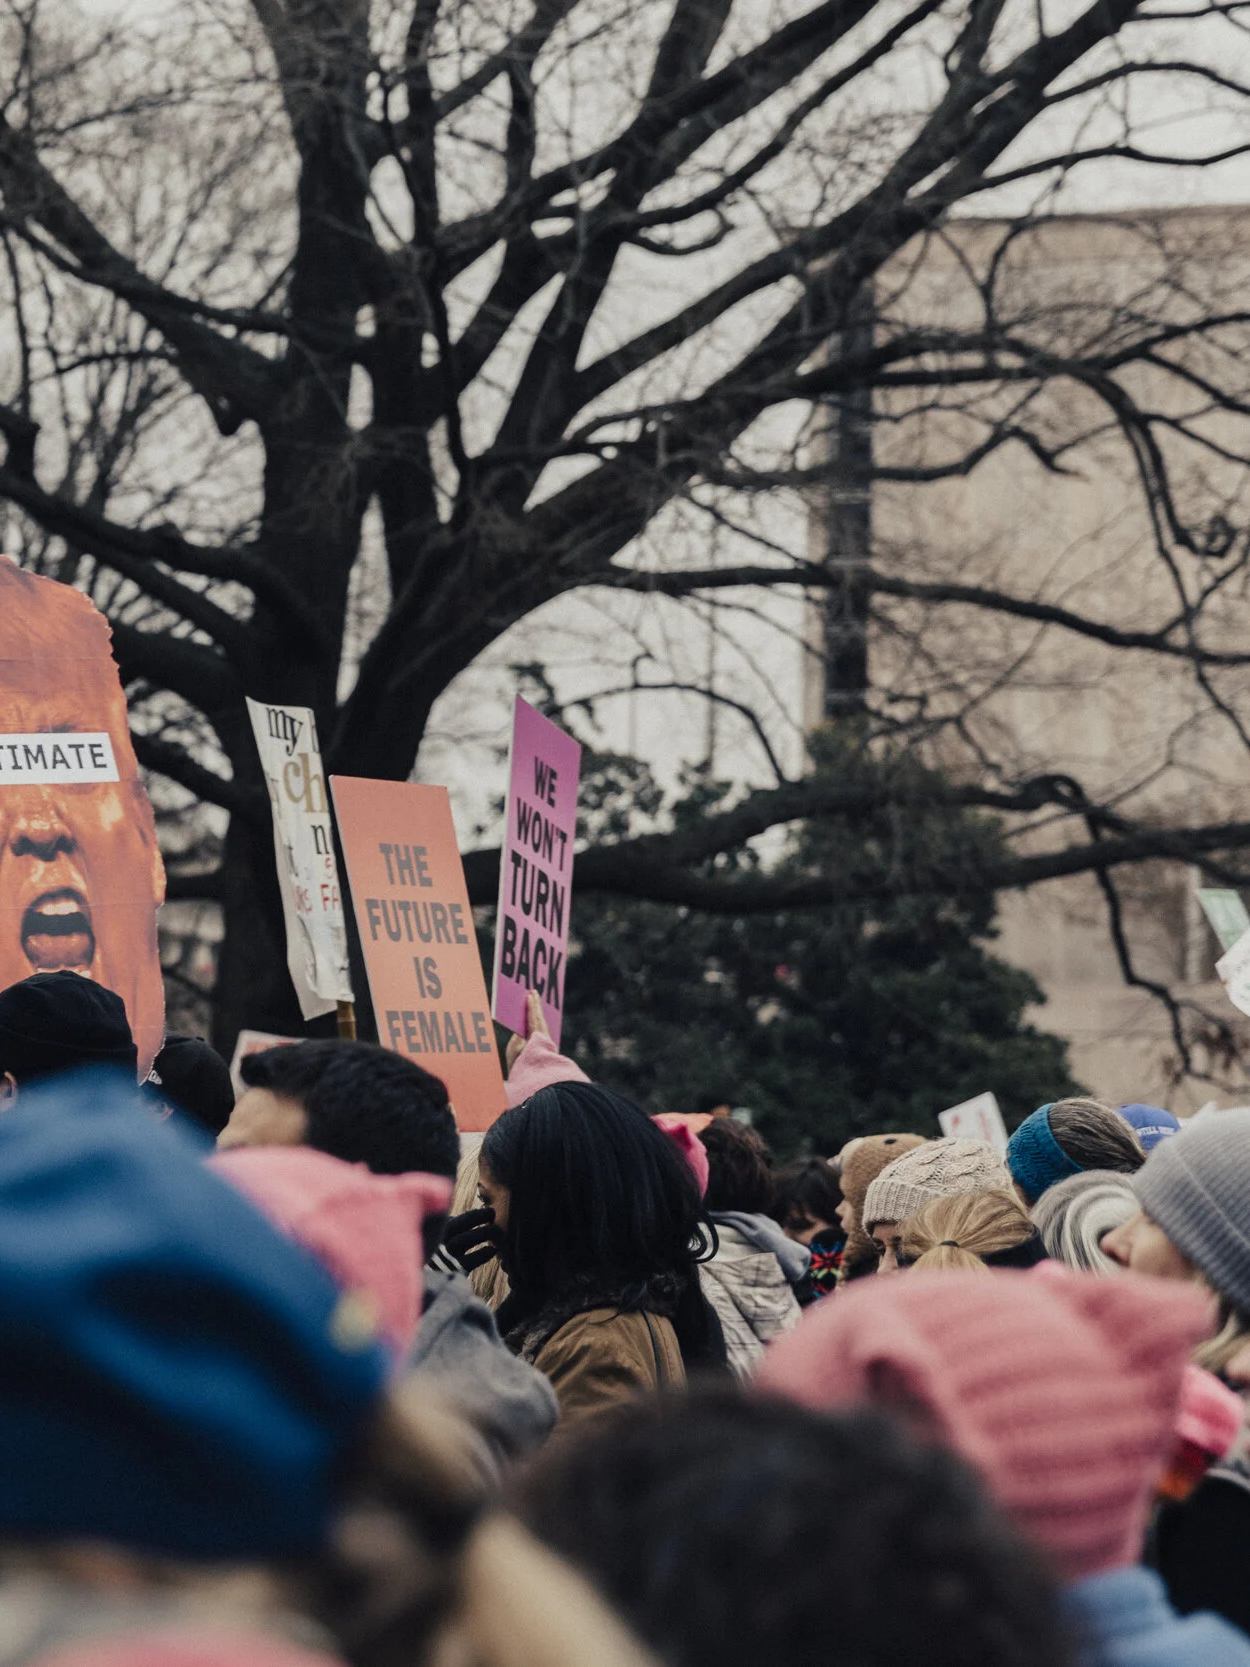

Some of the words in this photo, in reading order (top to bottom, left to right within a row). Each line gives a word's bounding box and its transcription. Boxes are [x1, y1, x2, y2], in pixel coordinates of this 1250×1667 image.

[534, 755, 558, 808] WE
[516, 796, 568, 872] WON'T
[378, 842, 433, 888] THE
[510, 848, 565, 939] TURN
[364, 897, 469, 945] FUTURE
[413, 956, 443, 1000] IS
[500, 913, 563, 1012] BACK
[385, 1010, 492, 1054] FEMALE
